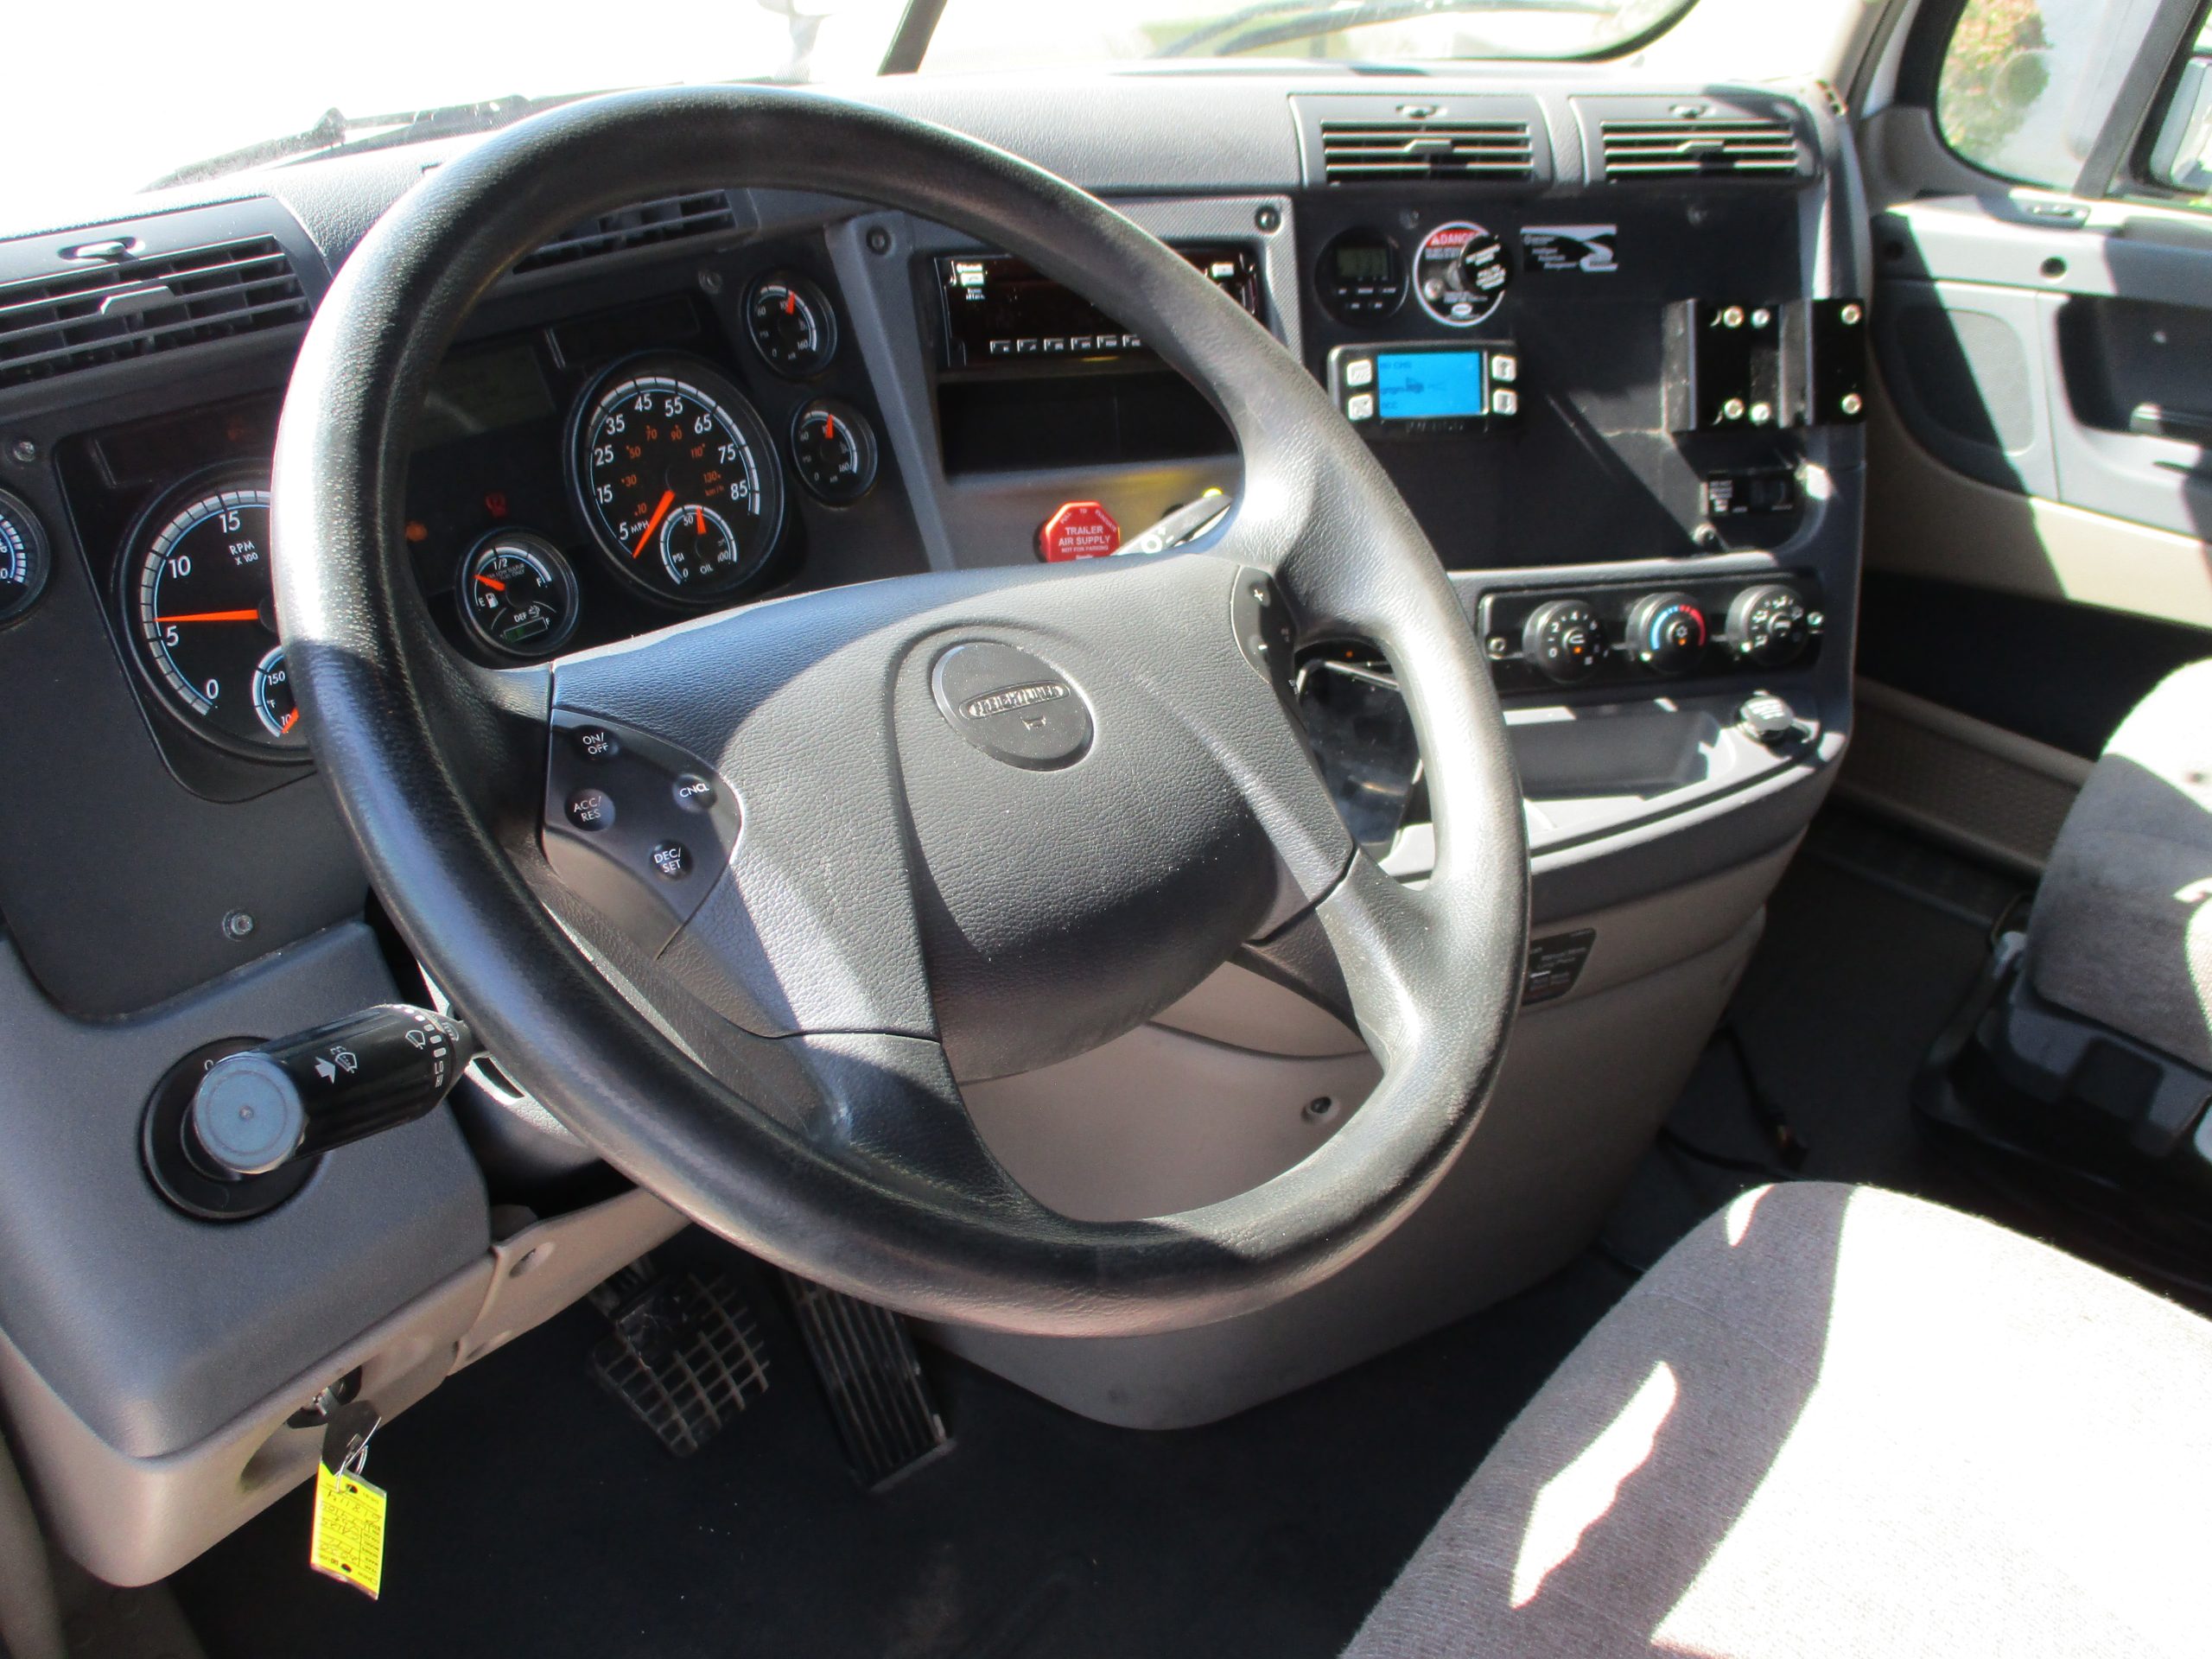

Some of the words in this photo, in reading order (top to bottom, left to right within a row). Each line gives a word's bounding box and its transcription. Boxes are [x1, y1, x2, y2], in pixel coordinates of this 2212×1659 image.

[772, 348, 778, 358] 0
[634, 394, 652, 412] 45
[664, 397, 683, 417] 55
[606, 415, 626, 435] 35
[694, 414, 712, 434] 65
[671, 429, 683, 441] 90
[594, 445, 614, 466] 25
[629, 447, 641, 460] 50
[690, 447, 703, 458] 110
[718, 443, 736, 463] 75
[625, 475, 637, 487] 30
[703, 471, 717, 483] 130
[814, 472, 820, 481] 0
[596, 484, 613, 505] 15
[730, 480, 748, 500] 85
[637, 503, 647, 514] 10
[219, 512, 241, 533] 15
[683, 515, 694, 526] 50
[620, 522, 629, 541] 5
[631, 521, 650, 534] MPH
[1065, 525, 1103, 536] TRAILER
[229, 540, 256, 556] RPM
[1058, 537, 1074, 547] AIR
[1076, 536, 1110, 545] SUPPLY
[235, 556, 243, 566] X
[243, 552, 259, 563] 100
[493, 557, 508, 570] 1/2
[672, 552, 685, 563] PSI
[168, 556, 192, 579] 10
[683, 568, 689, 578] 0
[700, 563, 714, 575] OIL
[537, 577, 542, 588] F
[479, 597, 486, 607] E
[513, 612, 527, 623] DEF
[545, 617, 550, 626] F
[1551, 621, 1560, 633] 2
[166, 626, 180, 647] 5
[267, 671, 286, 686] 150
[206, 678, 219, 700] 0
[583, 733, 605, 746] ON/
[588, 743, 609, 755] OFF
[679, 783, 710, 798] CNCL
[573, 796, 602, 813] ACC/
[581, 809, 601, 822] RES
[653, 847, 682, 864] DEC/
[662, 859, 682, 873] SET
